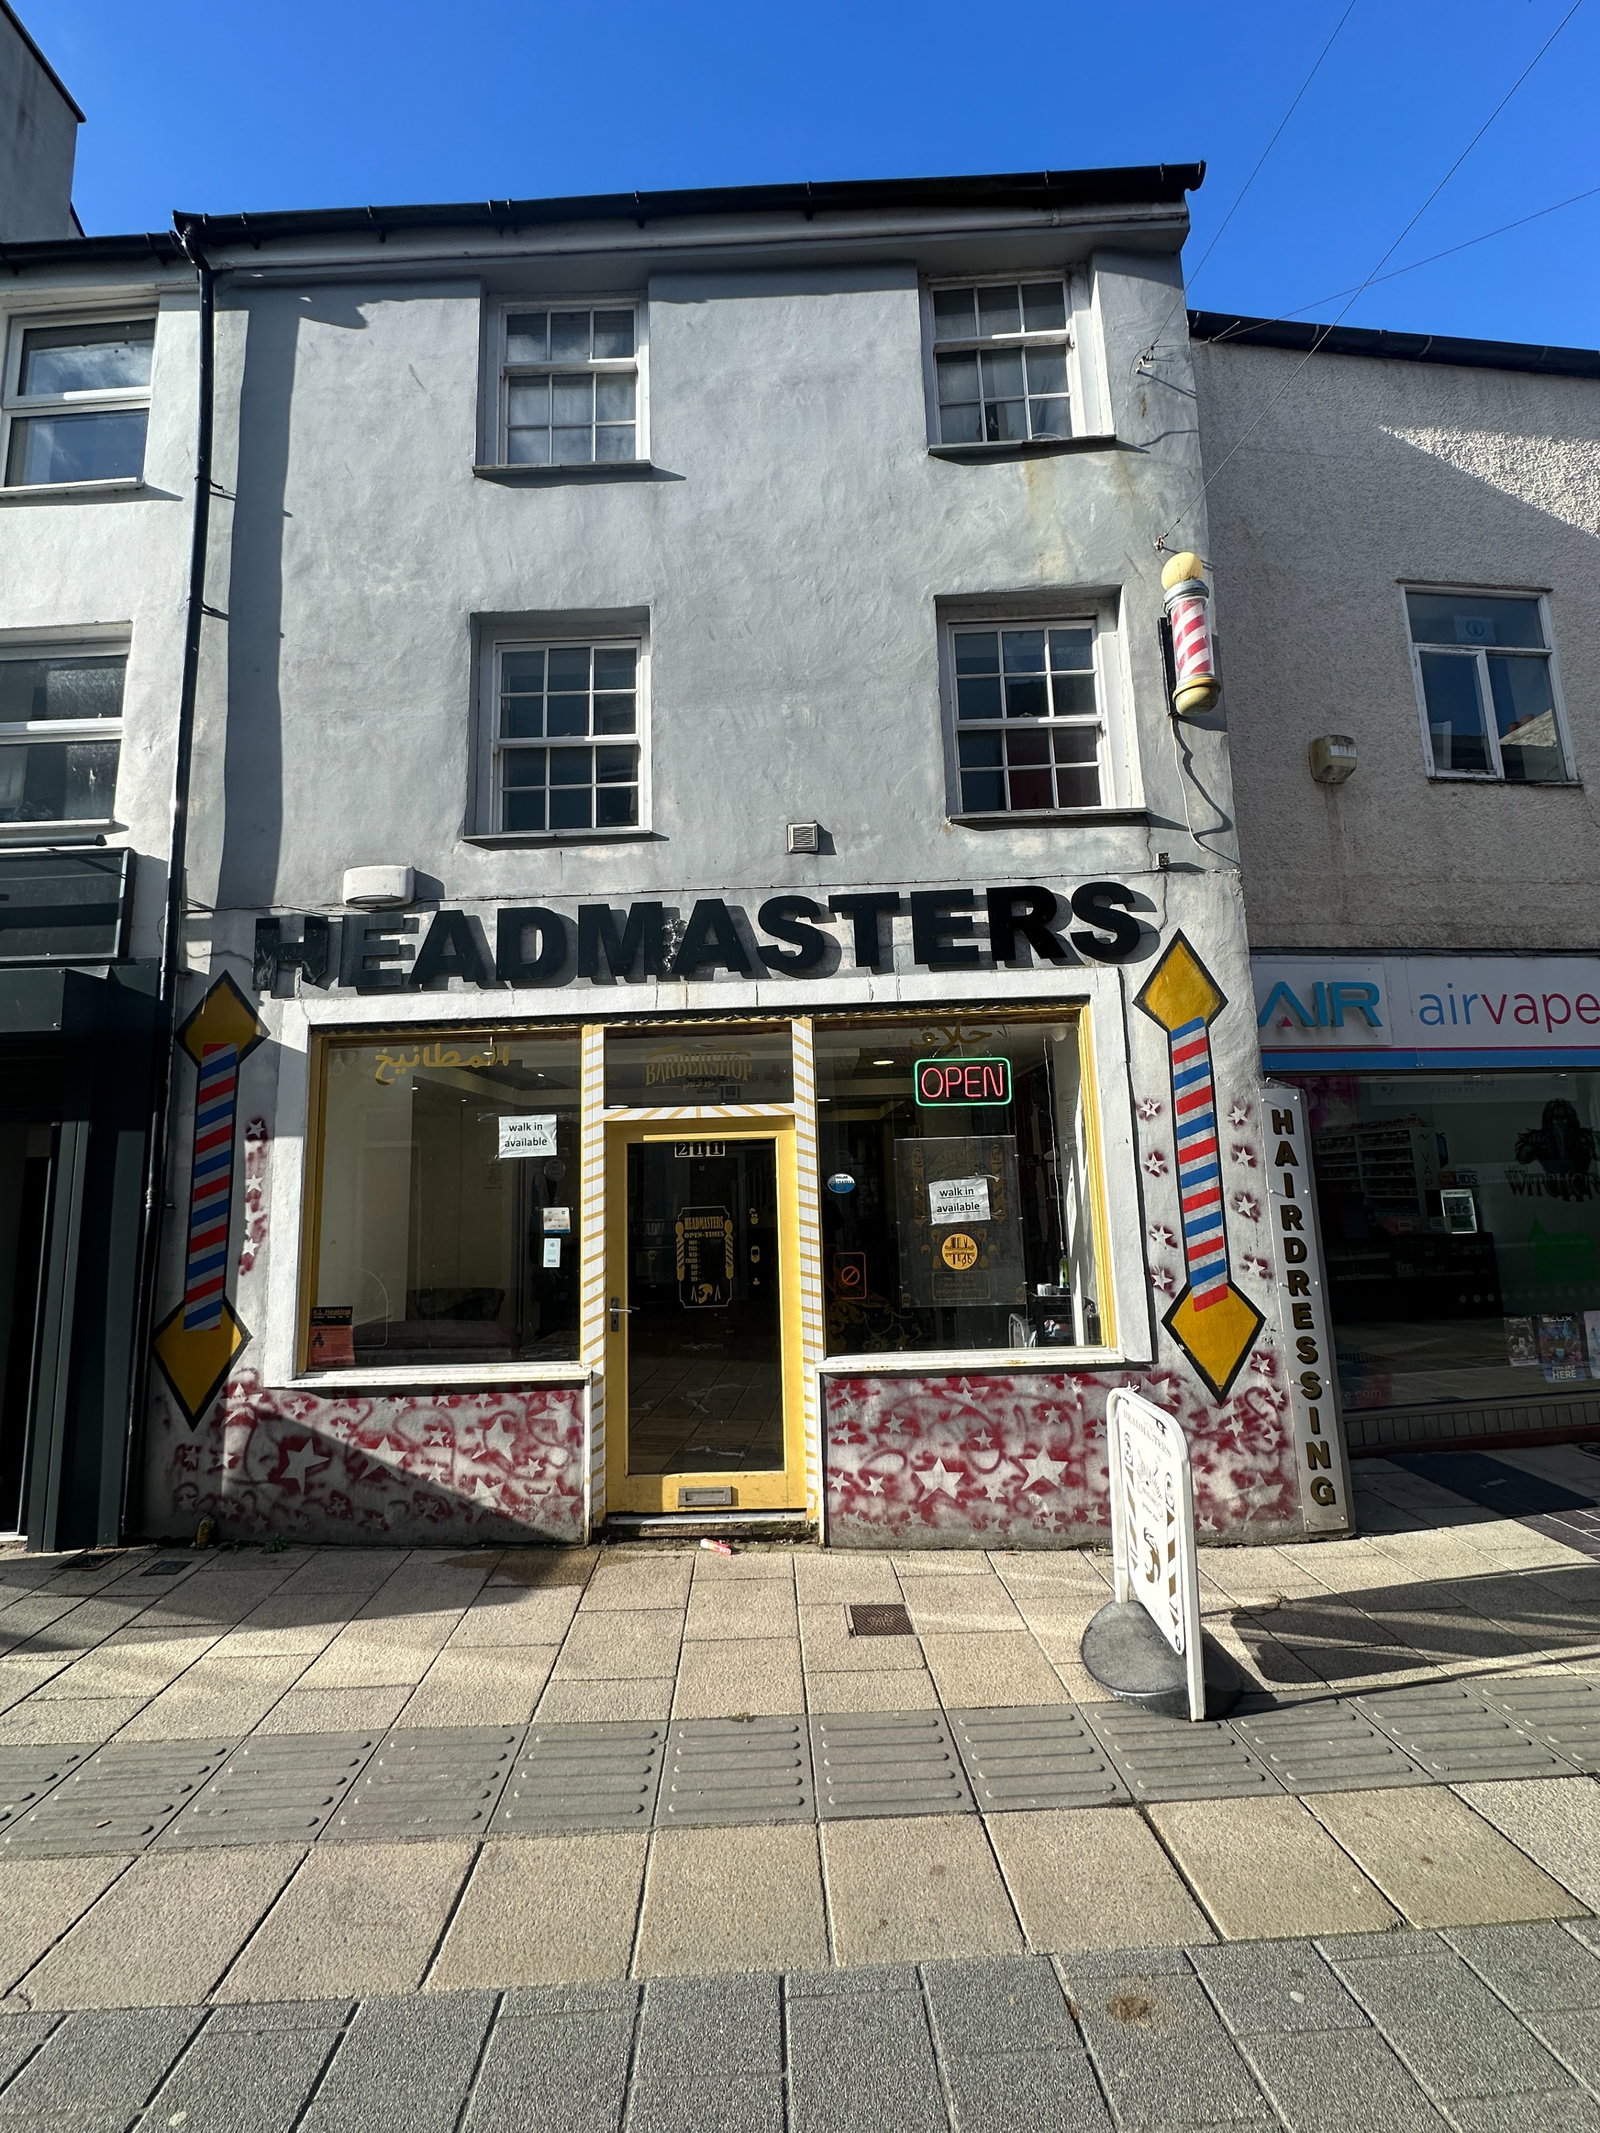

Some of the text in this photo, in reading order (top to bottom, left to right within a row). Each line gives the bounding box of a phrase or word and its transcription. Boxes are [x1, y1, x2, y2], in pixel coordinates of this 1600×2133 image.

[252, 881, 1140, 991] HEADMASTERS
[1257, 981, 1384, 1028] AIR
[644, 1052, 753, 1087] BARBERSHOP
[921, 1066, 1004, 1099] OPEN
[508, 1122, 543, 1132] walk in
[504, 1137, 548, 1148] available
[939, 1186, 975, 1197] walk in
[936, 1201, 981, 1214] available
[684, 1216, 724, 1231] HEADMASTERS
[1271, 1108, 1337, 1507] HAIRDRESSING
[1543, 1315, 1574, 1323] ELUX
[1552, 1369, 1577, 1379] HERE
